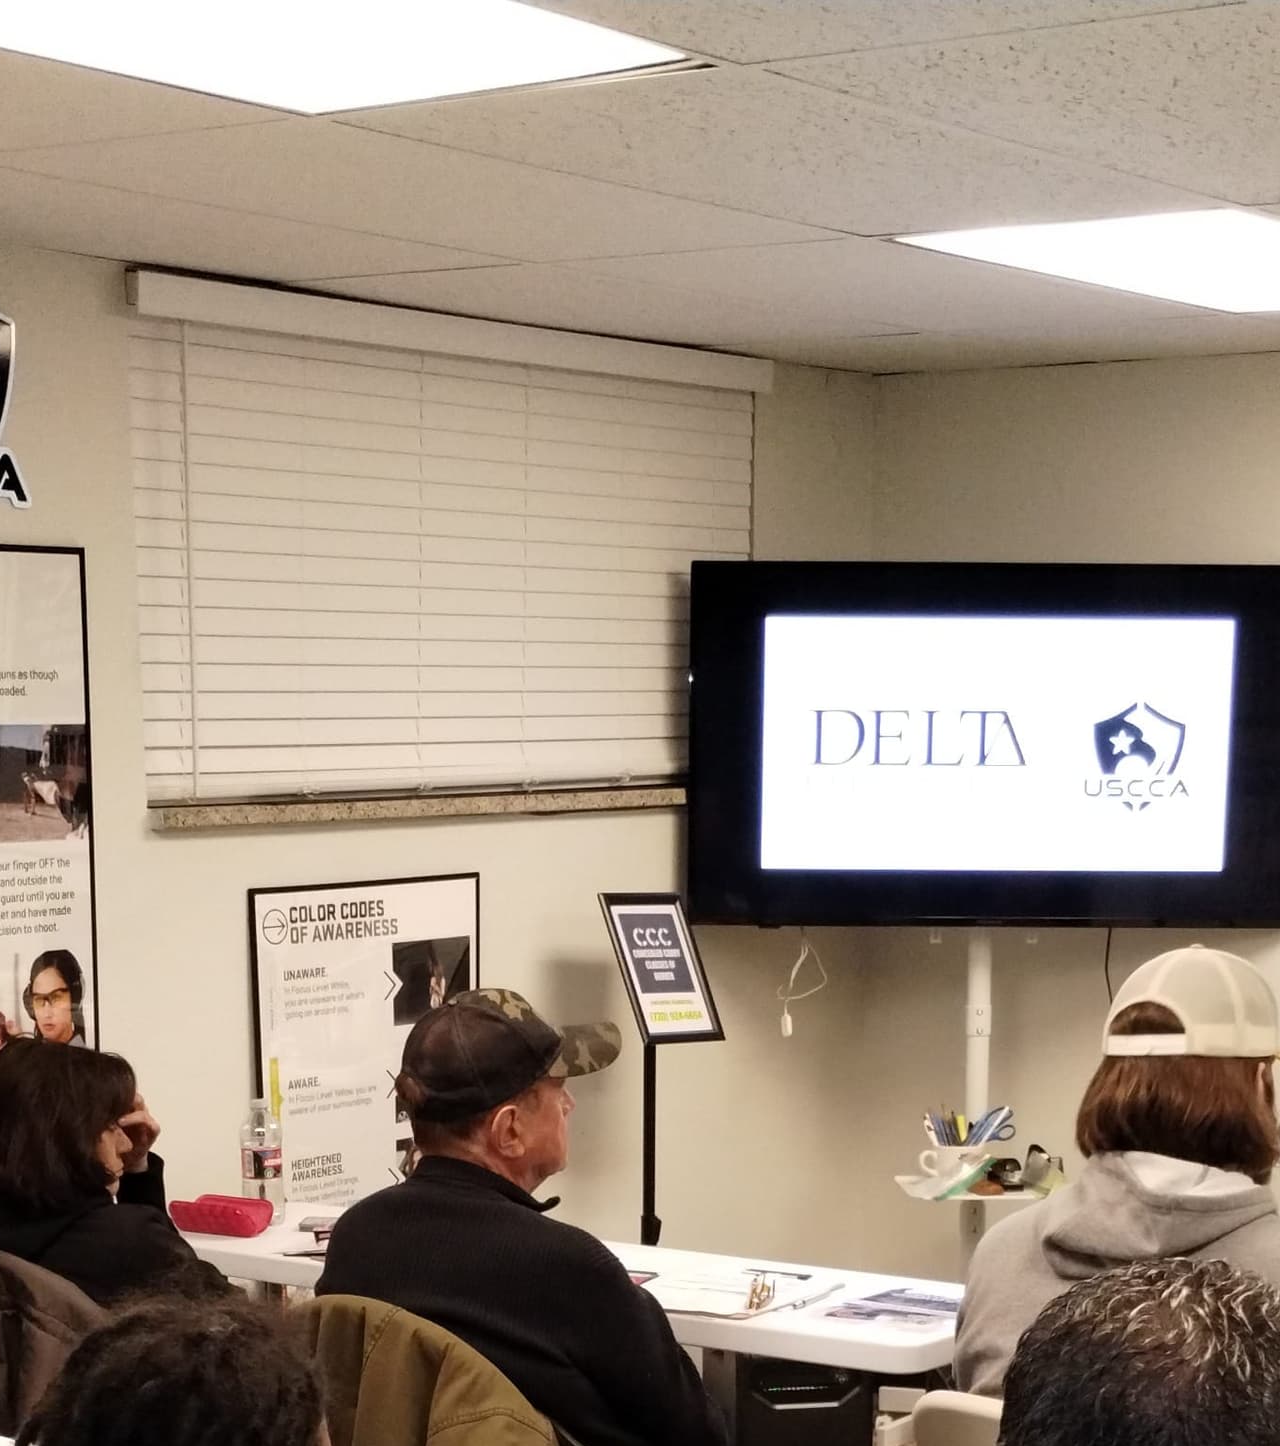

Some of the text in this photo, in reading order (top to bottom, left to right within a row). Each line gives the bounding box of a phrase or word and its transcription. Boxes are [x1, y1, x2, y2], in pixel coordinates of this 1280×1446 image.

[17, 672, 28, 680] as
[28, 669, 58, 683] though
[810, 709, 1026, 766] DELTA
[1084, 779, 1189, 798] USCCA
[12, 859, 36, 873] finger
[38, 858, 53, 869] OFF
[56, 857, 70, 868] the
[0, 875, 15, 887] and
[16, 874, 47, 886] outside
[48, 873, 62, 885] the
[289, 899, 384, 923] COLOR CODES
[290, 917, 398, 944] OF AWARENESS
[633, 928, 672, 947] CCC
[291, 1153, 342, 1170] HEIGHTENED
